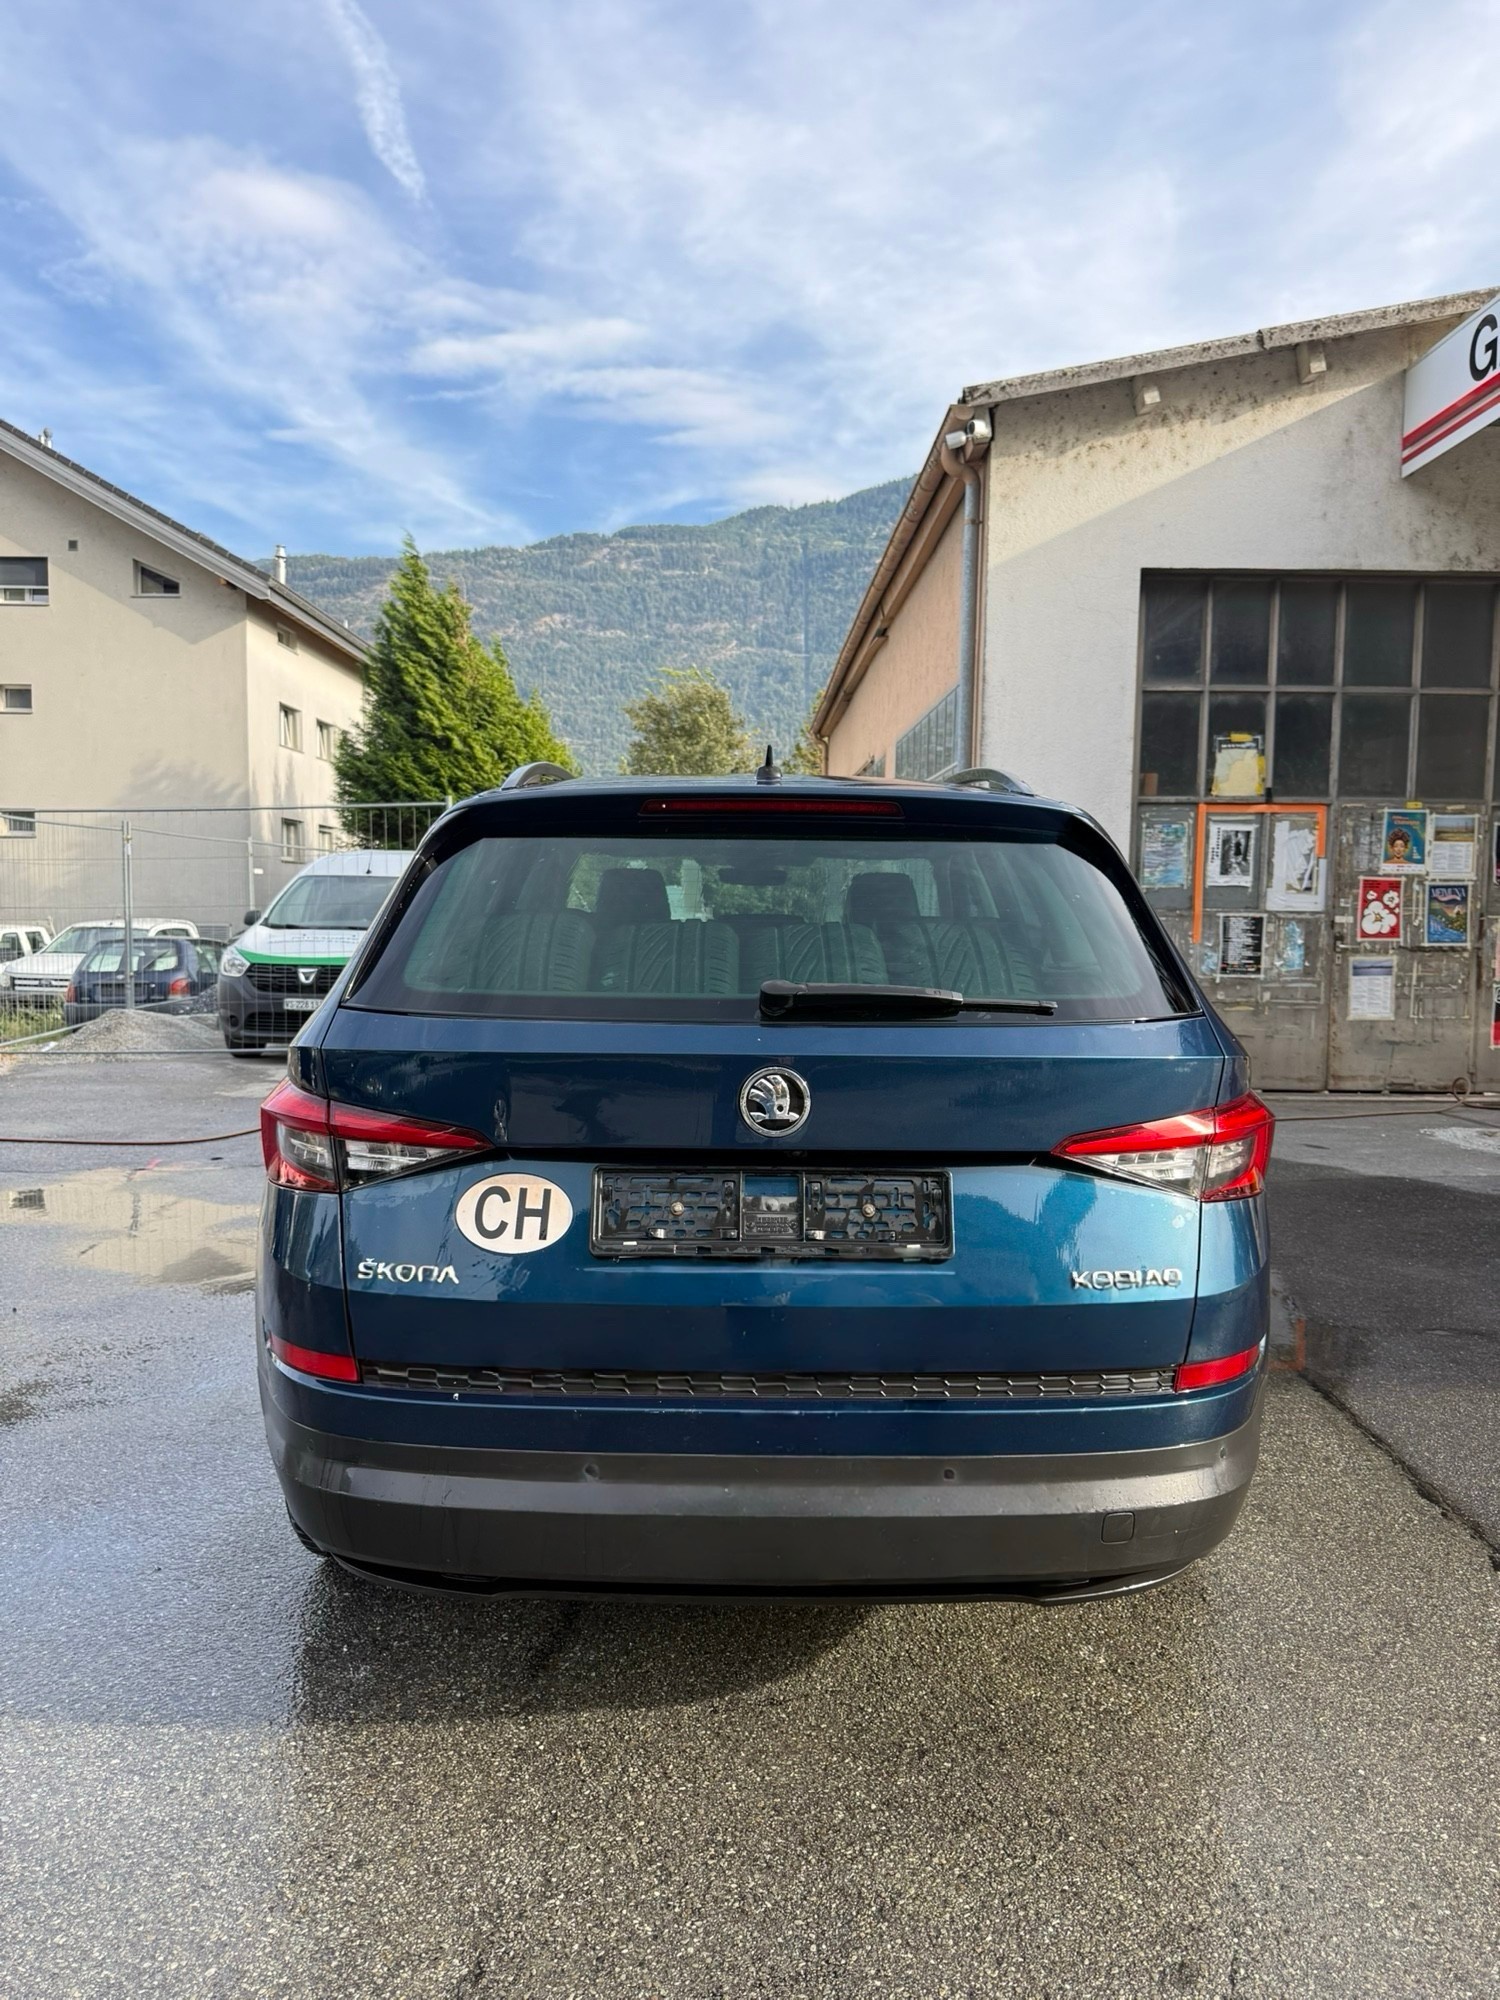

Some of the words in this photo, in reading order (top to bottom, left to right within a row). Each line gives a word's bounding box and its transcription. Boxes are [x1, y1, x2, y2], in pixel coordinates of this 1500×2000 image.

[1469, 313, 1500, 382] G
[474, 1185, 552, 1241] CH
[357, 1257, 460, 1285] ŠKODA
